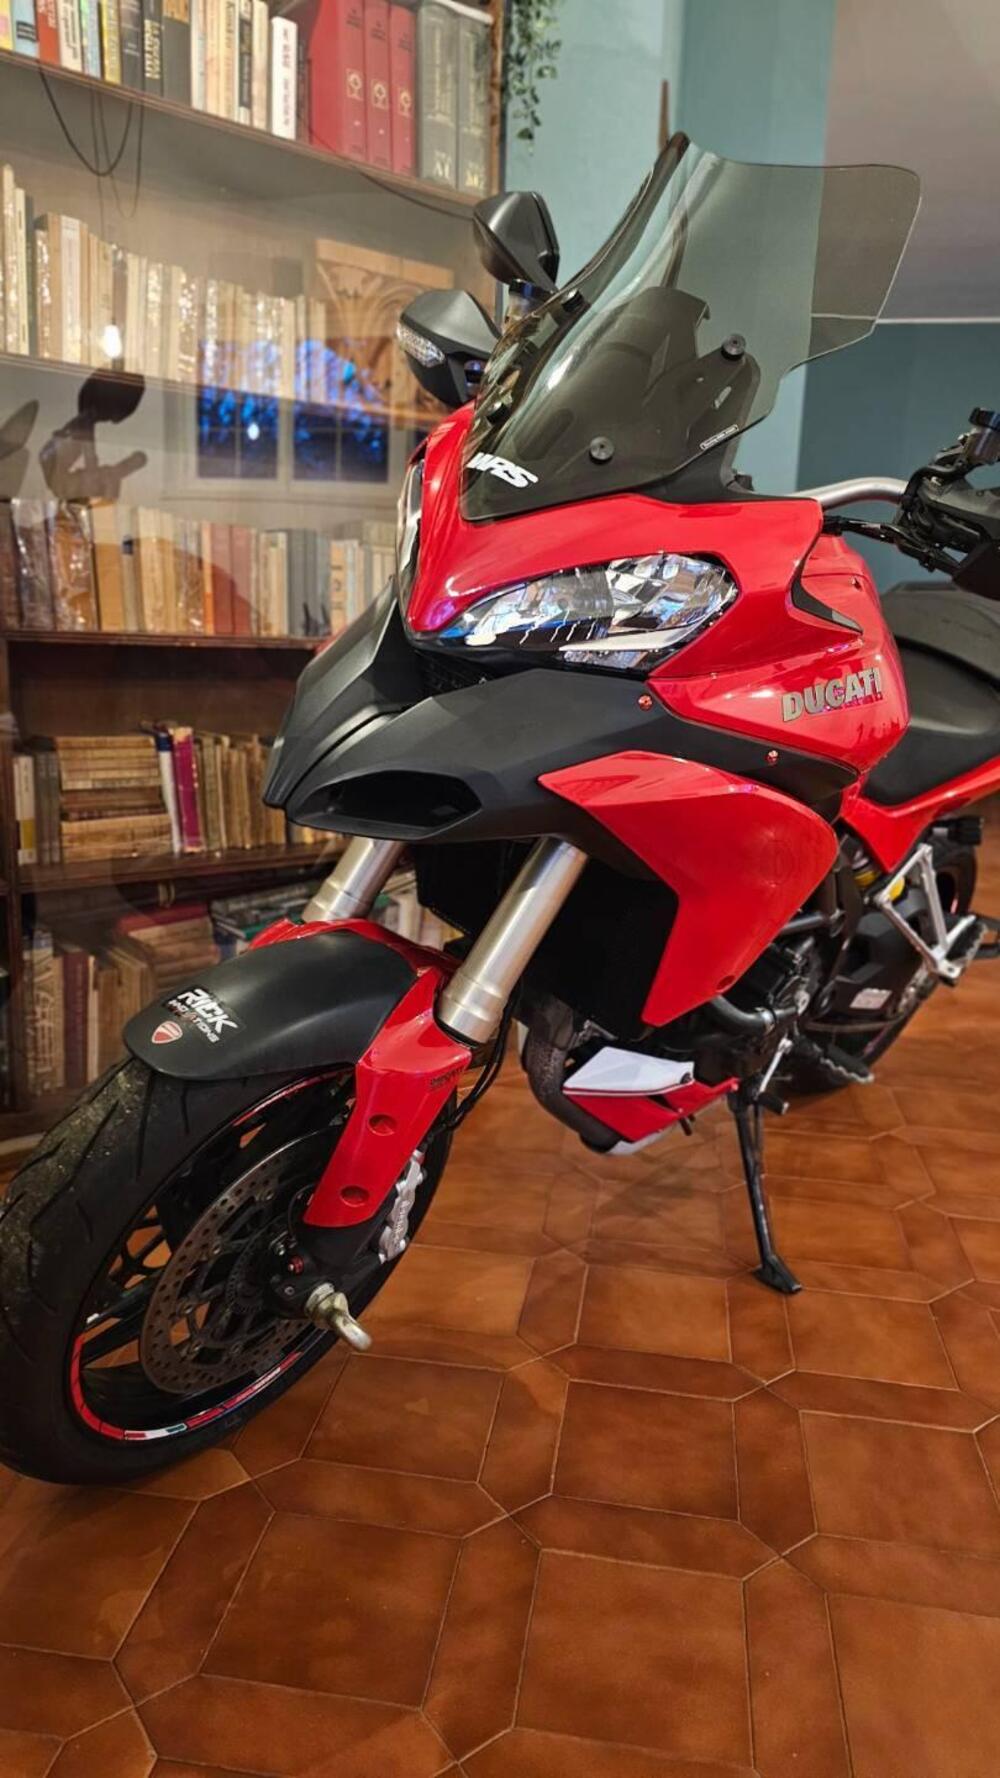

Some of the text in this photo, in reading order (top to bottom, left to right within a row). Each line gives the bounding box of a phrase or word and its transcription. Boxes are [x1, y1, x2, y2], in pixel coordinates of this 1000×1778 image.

[466, 452, 539, 488] WRS
[782, 667, 881, 722] DUCATI
[177, 989, 239, 1033] RICK
